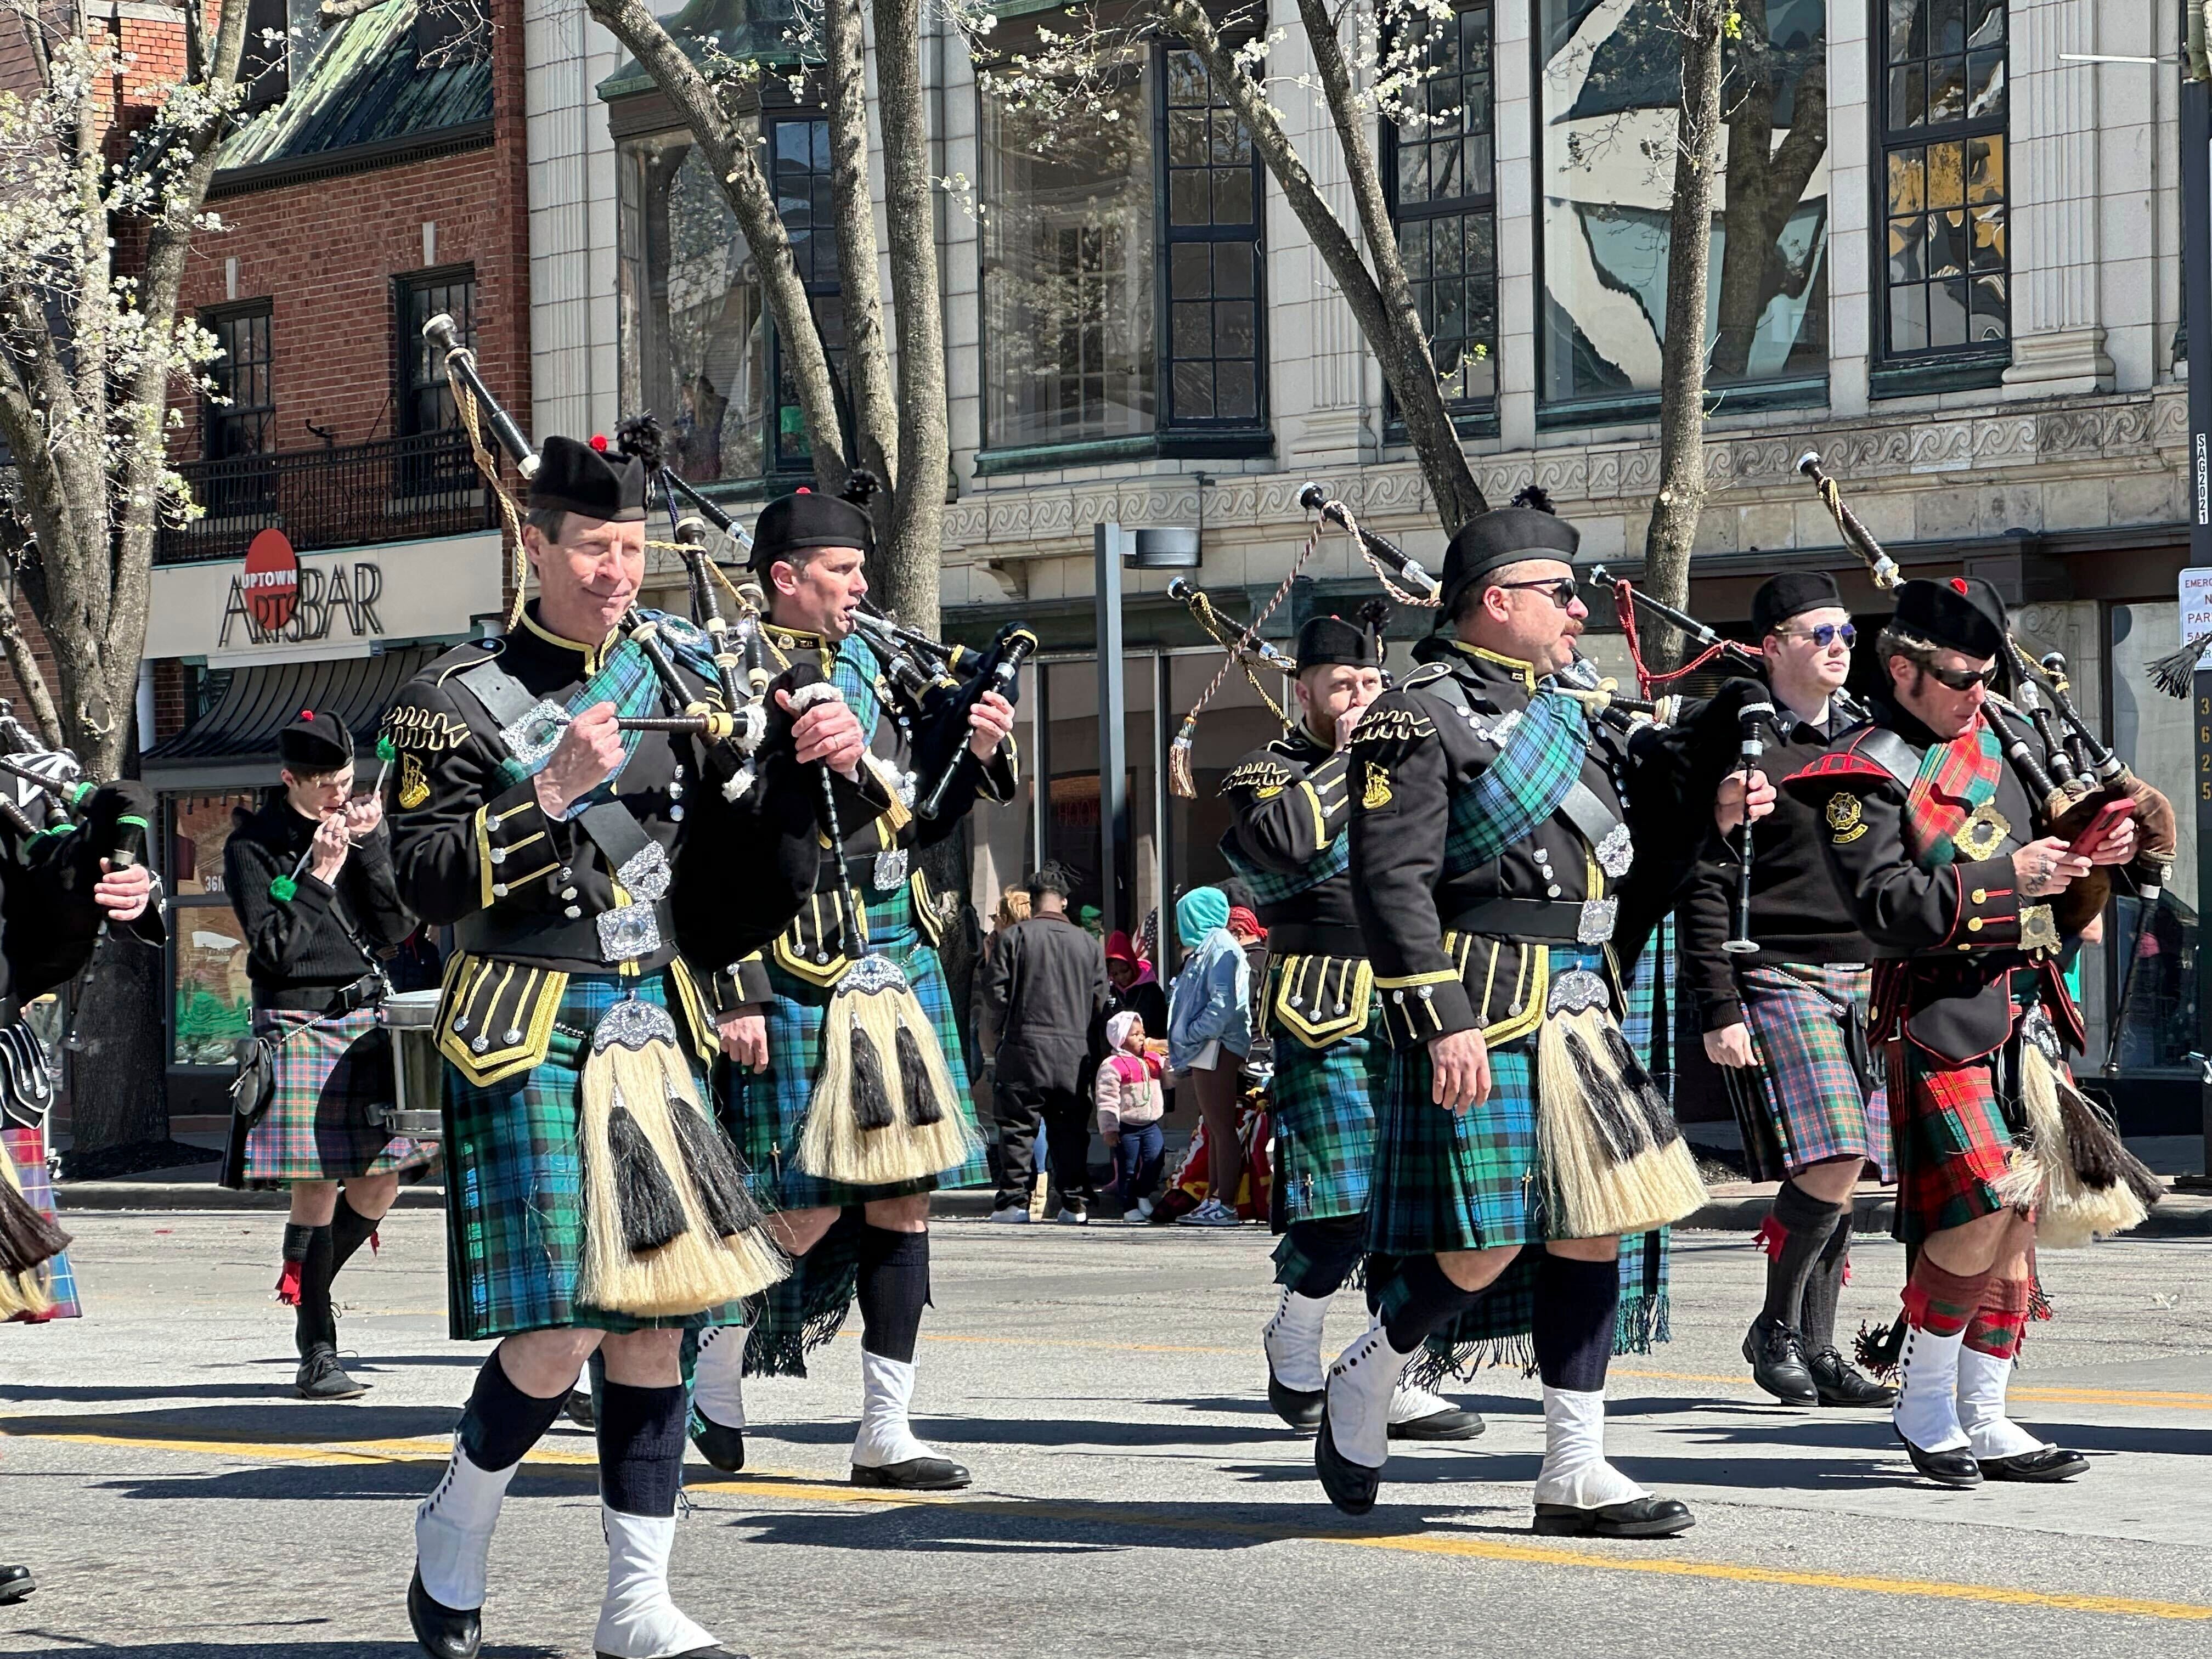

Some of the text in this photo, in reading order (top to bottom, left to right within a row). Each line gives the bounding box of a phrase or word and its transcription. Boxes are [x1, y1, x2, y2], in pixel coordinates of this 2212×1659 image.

[241, 569, 298, 589] UPTOWN
[2188, 612, 2212, 624] PAR
[2201, 697, 2211, 800] 3625
